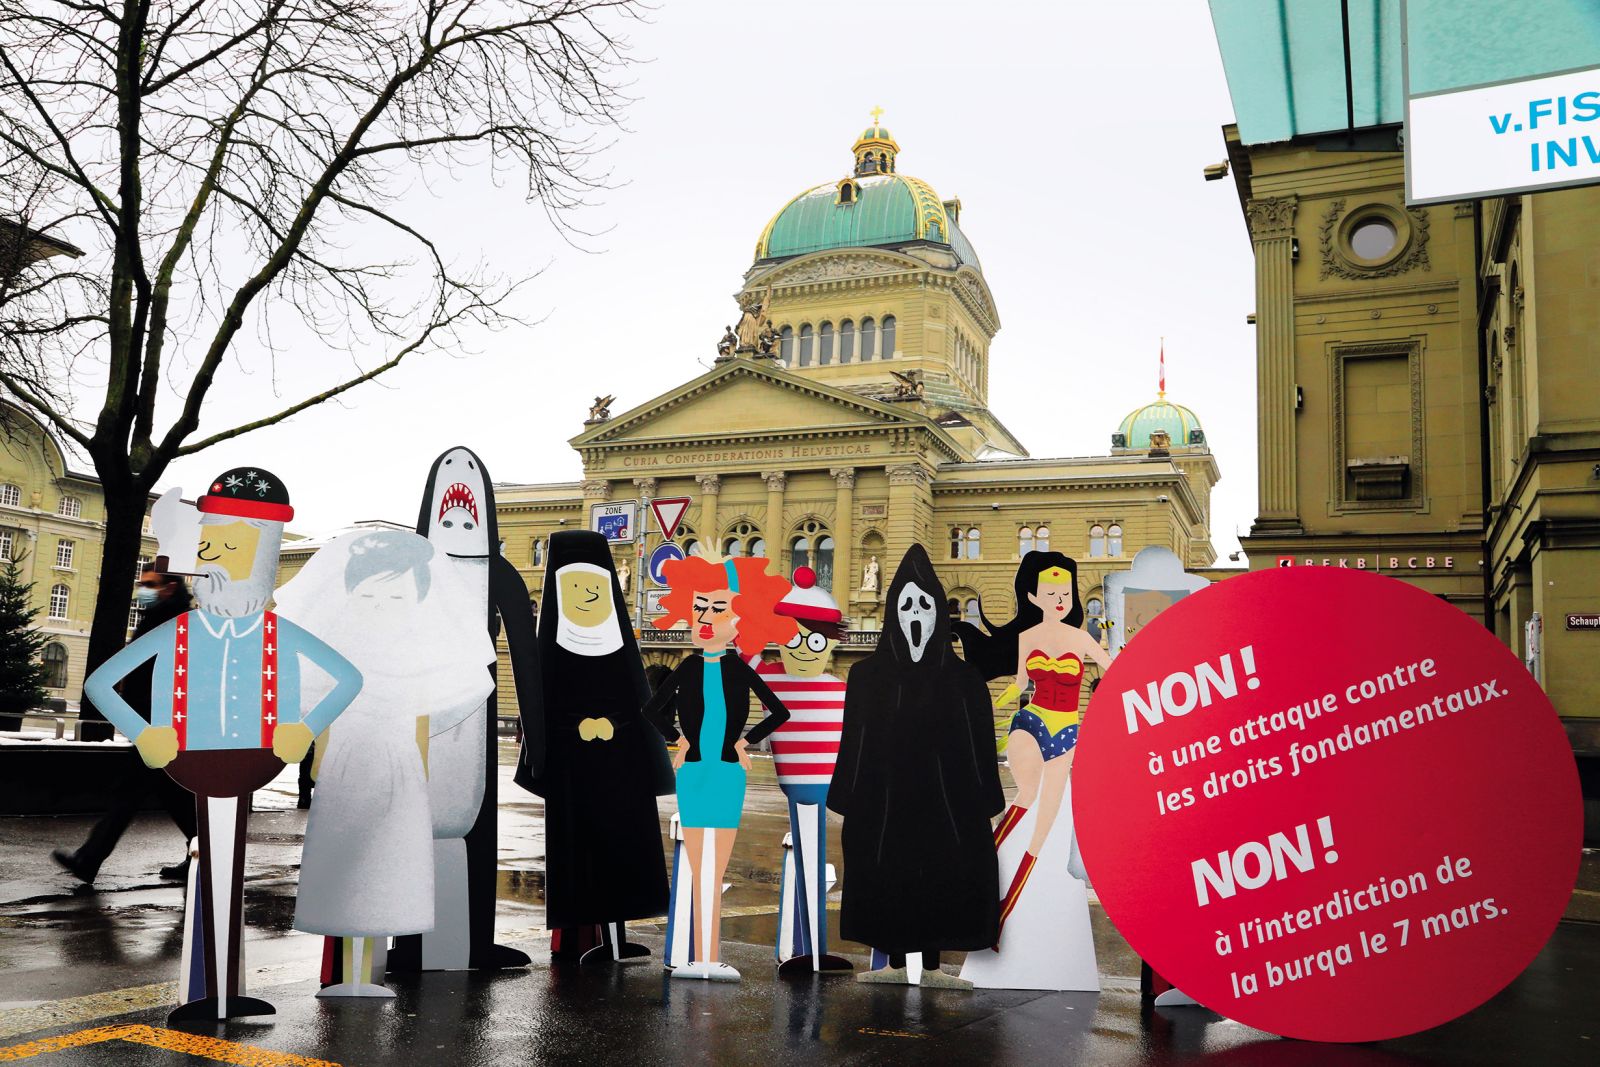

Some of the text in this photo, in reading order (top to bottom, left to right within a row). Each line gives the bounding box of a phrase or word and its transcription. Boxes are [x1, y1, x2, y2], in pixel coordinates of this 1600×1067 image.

[623, 457, 658, 467] CURIA
[792, 445, 871, 458] HELVETICAE
[605, 507, 622, 515] ZONE
[1390, 557, 1453, 569] BCBE
[1148, 658, 1437, 776] à une attaque contre
[1156, 679, 1509, 816] les droits fondamentaux.
[1215, 930, 1233, 956] à
[1436, 855, 1473, 884] de
[1230, 898, 1508, 999] la burqa le 7 mars.
